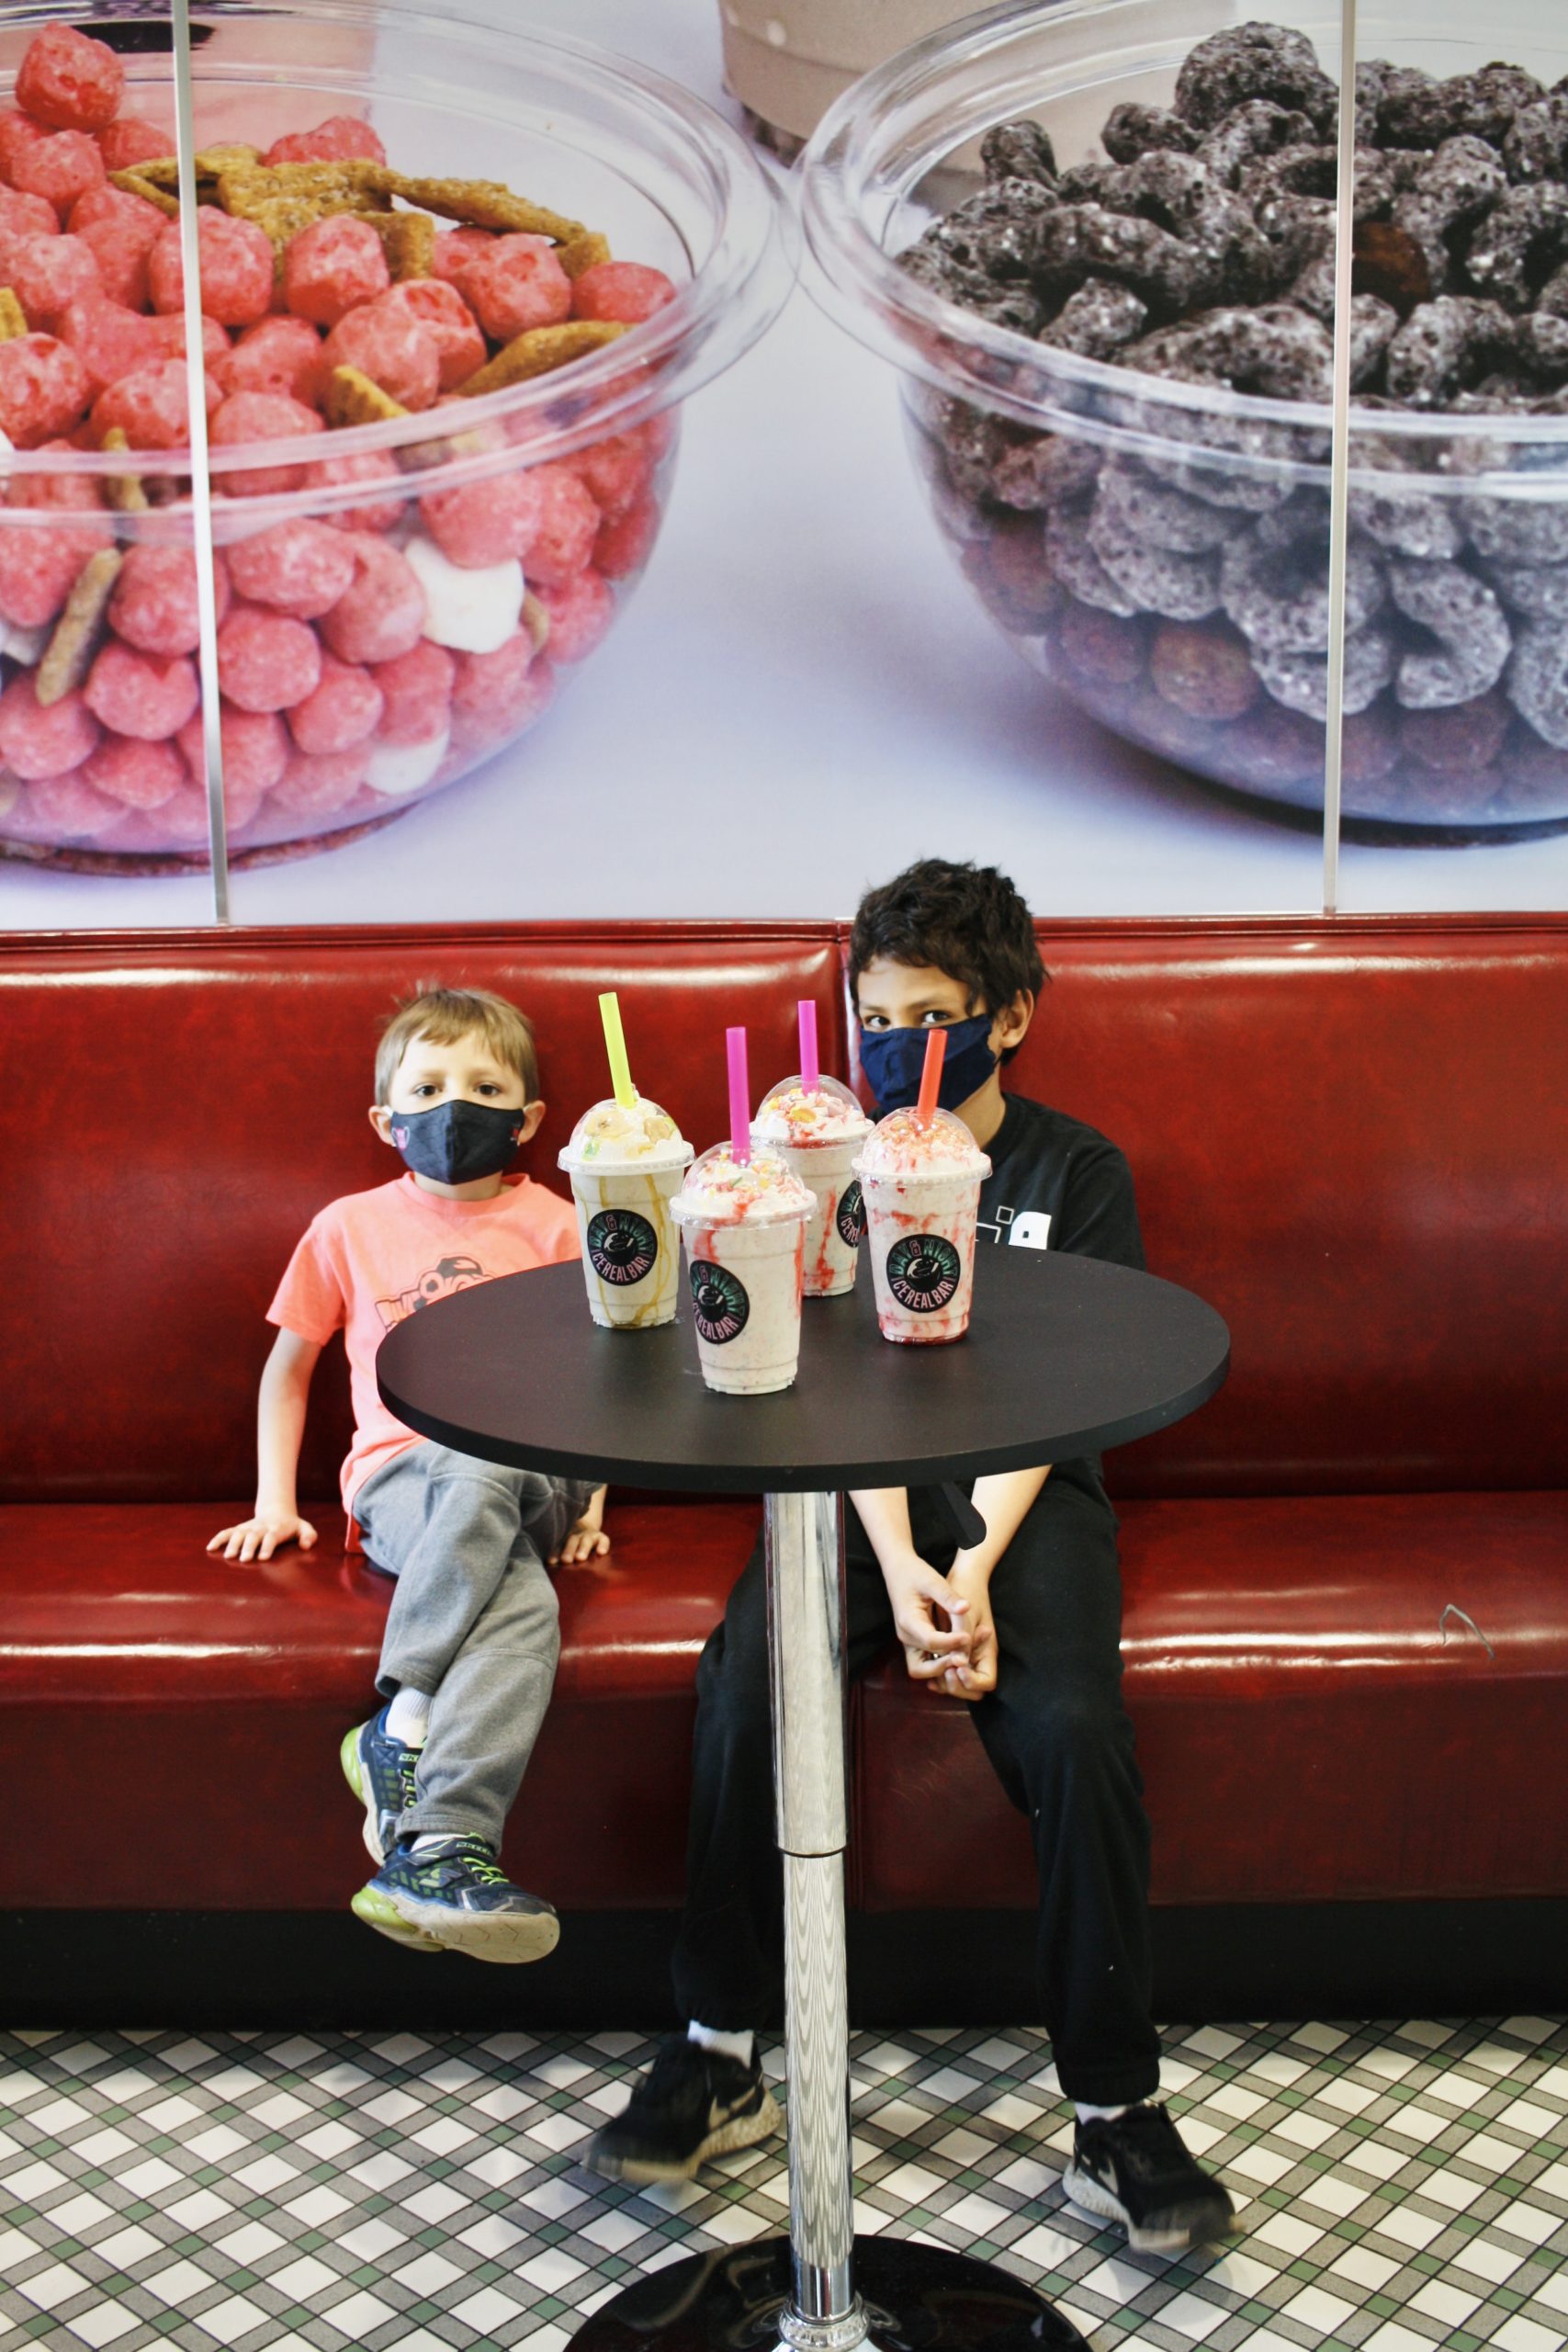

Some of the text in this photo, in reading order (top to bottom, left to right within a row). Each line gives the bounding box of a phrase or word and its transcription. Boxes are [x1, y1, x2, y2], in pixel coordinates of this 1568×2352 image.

[619, 1214, 655, 1253] NIGHT
[592, 1252, 650, 1282] CEREAL BAR
[889, 1242, 912, 1275] DAY
[923, 1238, 958, 1277] NIGHT
[710, 1268, 745, 1317] NIGHT
[893, 1280, 954, 1308] CEREAL BAR
[715, 1316, 739, 1339] BAR
